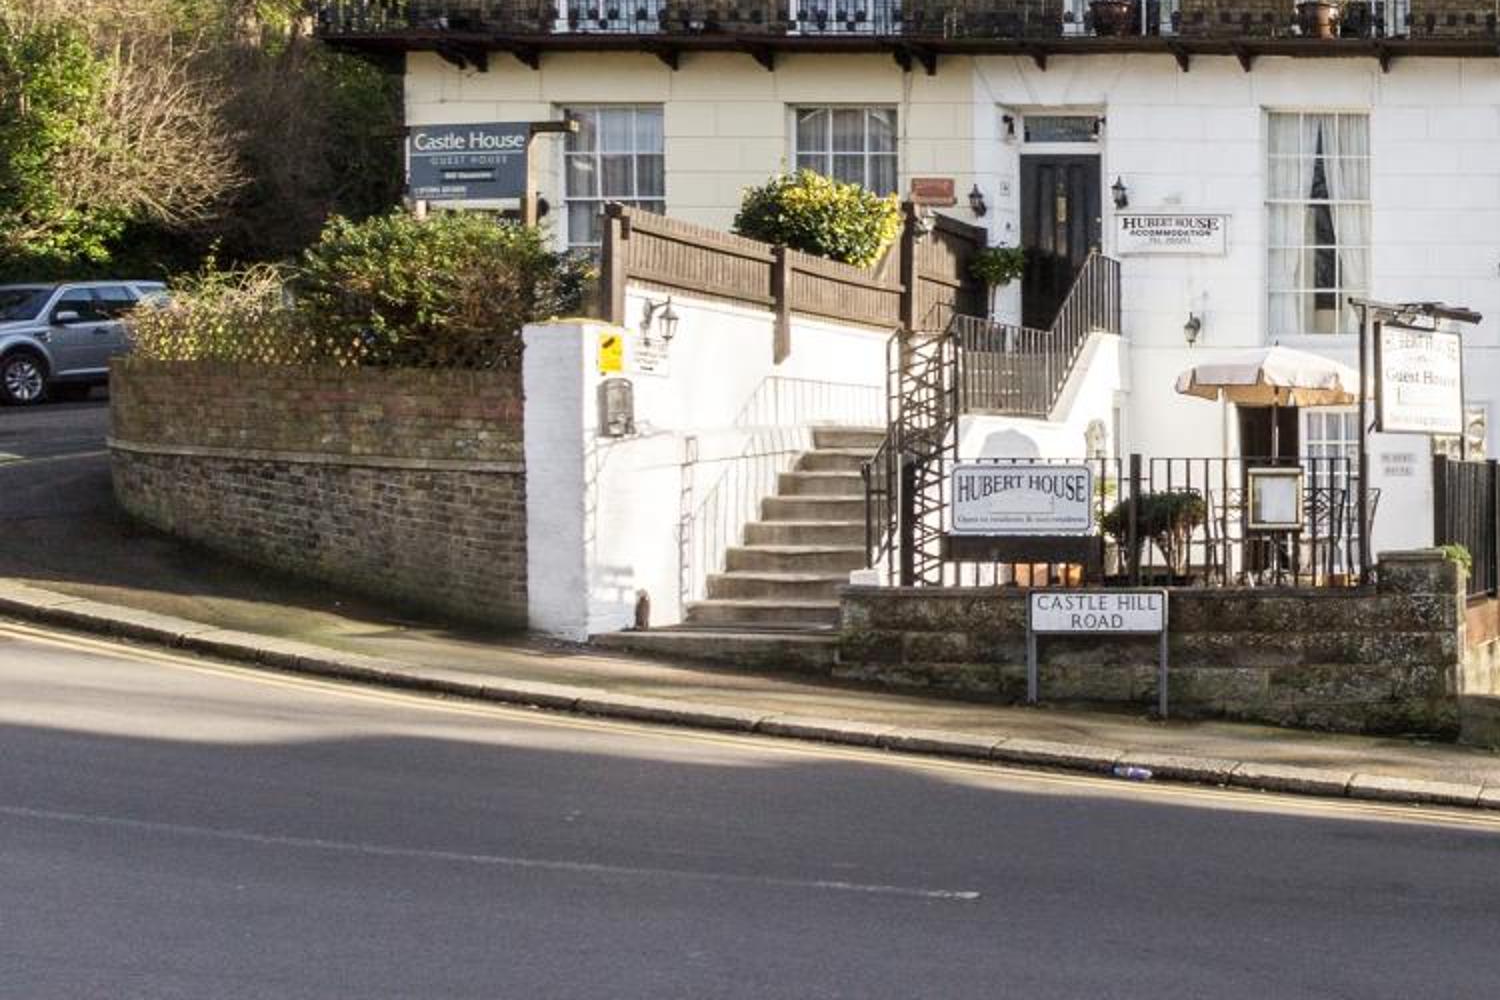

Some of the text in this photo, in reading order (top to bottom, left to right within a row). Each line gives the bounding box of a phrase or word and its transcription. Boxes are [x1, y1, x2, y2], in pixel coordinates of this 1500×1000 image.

[414, 131, 525, 151] Castle House
[1122, 217, 1219, 230] HUBERT HOUSE
[957, 475, 1086, 503] HUBERT HOUSE
[1037, 596, 1157, 611] CASTLE HILL
[1071, 614, 1123, 629] ROAD
